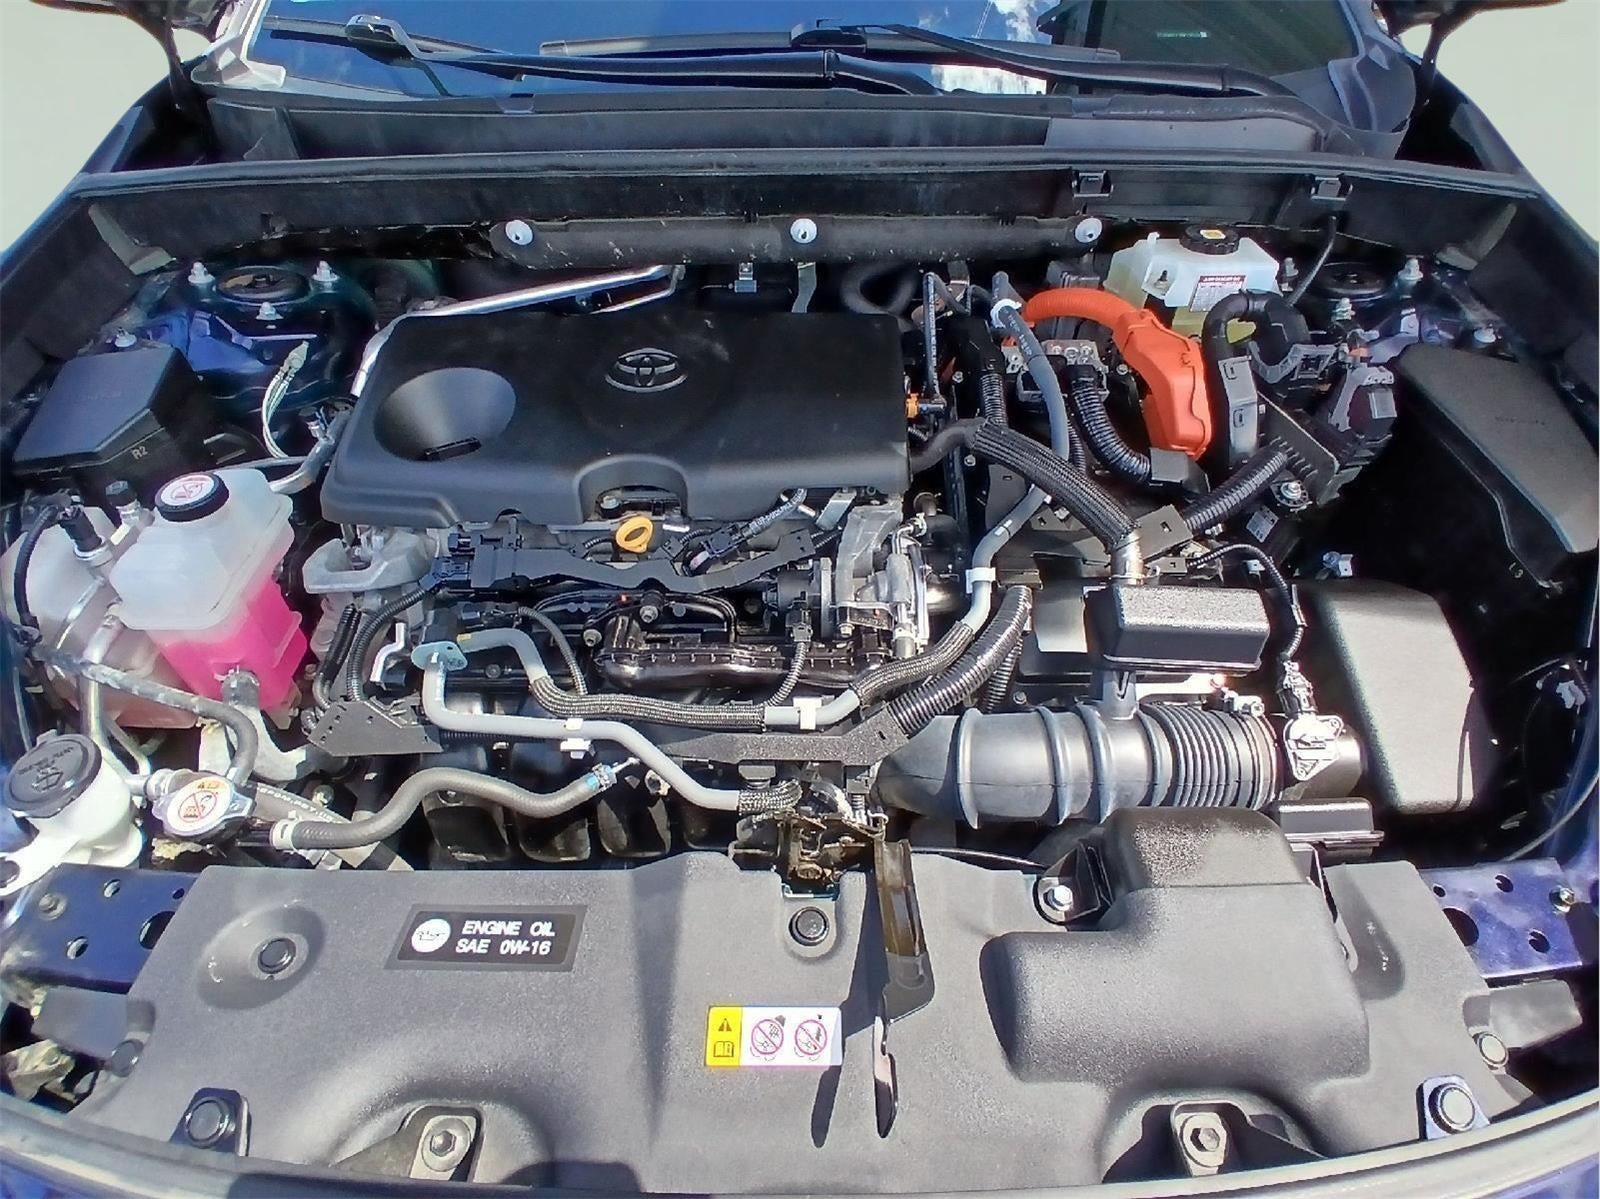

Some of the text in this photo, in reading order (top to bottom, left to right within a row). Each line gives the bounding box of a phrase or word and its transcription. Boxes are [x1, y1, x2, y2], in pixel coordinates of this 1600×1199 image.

[132, 446, 148, 459] R2
[461, 919, 556, 937] ENGINE OIL
[455, 938, 552, 956] SAE 0W-16
